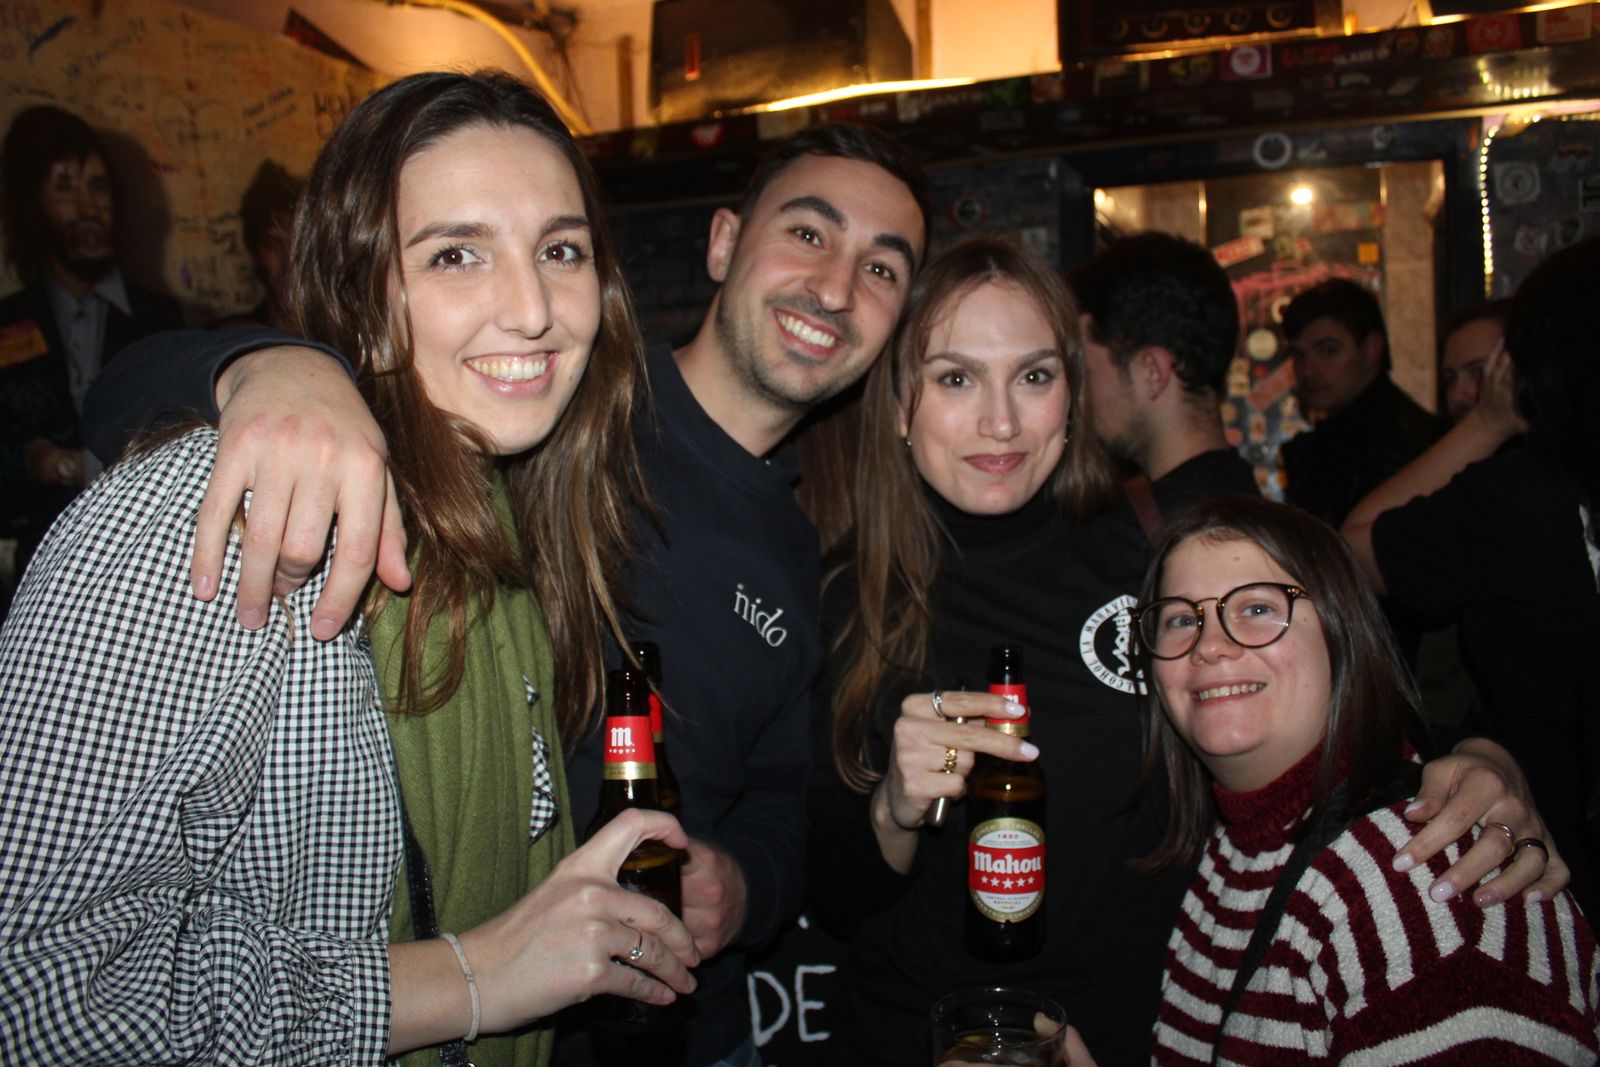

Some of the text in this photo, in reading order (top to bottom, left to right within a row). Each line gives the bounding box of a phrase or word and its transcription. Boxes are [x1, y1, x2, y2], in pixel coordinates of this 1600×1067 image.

[1088, 660, 1133, 691] LCOHOL
[973, 851, 1041, 874] Mahou
[747, 965, 837, 1047] DE
